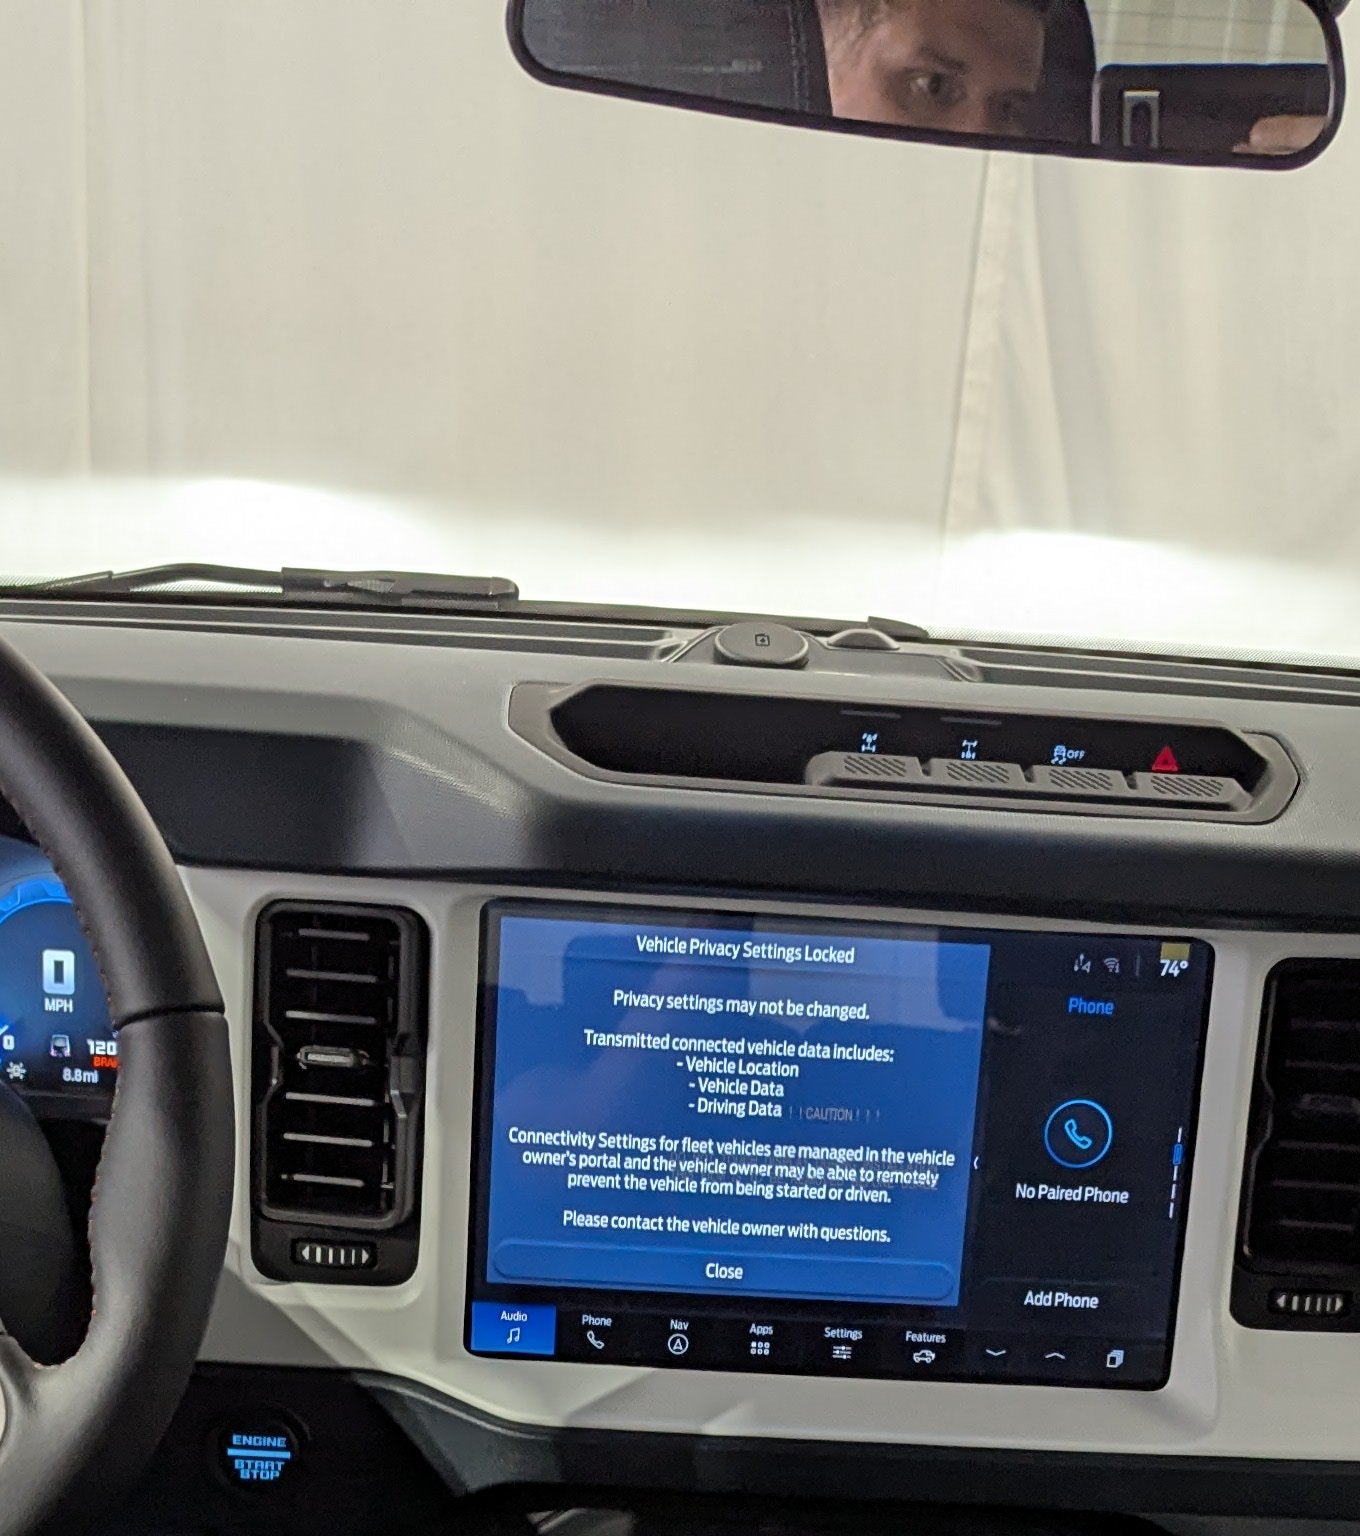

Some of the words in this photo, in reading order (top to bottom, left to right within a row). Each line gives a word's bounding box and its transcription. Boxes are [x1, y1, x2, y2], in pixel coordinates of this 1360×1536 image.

[1067, 750, 1085, 759] OFF
[636, 935, 687, 954] Vehicle
[689, 937, 740, 959] Privacy
[742, 941, 802, 963] Settings
[804, 945, 855, 964] Locked
[42, 949, 75, 995] 0
[44, 997, 74, 1013] MPH
[613, 989, 663, 1010] Privacy
[666, 993, 724, 1014] settings
[726, 998, 757, 1016] may
[759, 1000, 784, 1015] not
[786, 1000, 804, 1017] be
[806, 1003, 870, 1022] changed.
[1067, 996, 1114, 1016] Phone
[2, 1035, 15, 1050] 0
[584, 1029, 670, 1050] Transmitted
[671, 1034, 745, 1054] connected
[747, 1040, 796, 1058] vehicle
[797, 1041, 831, 1059] data
[832, 1044, 895, 1063] includes:
[686, 1056, 736, 1074] Vehicle
[738, 1059, 799, 1078] Location
[698, 1077, 748, 1096] Vehicle
[750, 1080, 784, 1098] Data
[697, 1097, 746, 1118] Driving
[748, 1100, 782, 1118] Data
[805, 1106, 853, 1122] CAUTION
[508, 1127, 596, 1149] Connectivity
[598, 1132, 656, 1152] Settings
[659, 1135, 680, 1151] for
[681, 1136, 713, 1154] fleet
[716, 1139, 771, 1157] vehicles
[774, 1145, 797, 1158] are
[798, 1146, 864, 1163] managed
[866, 1148, 880, 1162] in
[881, 1148, 905, 1164] the
[907, 1149, 955, 1167] vehicle
[522, 1151, 576, 1168] owner's
[579, 1153, 621, 1170] portal
[623, 1154, 650, 1171] and
[652, 1156, 676, 1172] the
[678, 1157, 727, 1176] vehicle
[729, 1162, 772, 1177] owner
[774, 1164, 805, 1181] may
[807, 1163, 824, 1179] be
[826, 1164, 856, 1182] able
[859, 1166, 874, 1182] to
[876, 1168, 939, 1188] remotely
[567, 1173, 621, 1190] prevent
[624, 1174, 648, 1191] the
[649, 1176, 698, 1193] vehicle
[700, 1178, 734, 1195] from
[735, 1181, 774, 1200] being
[776, 1182, 826, 1200] started
[828, 1187, 843, 1201] or
[845, 1186, 892, 1204] driven.
[1016, 1182, 1036, 1199] No
[1037, 1183, 1083, 1202] Paired
[1084, 1186, 1129, 1204] Phone
[563, 1210, 609, 1228] Please
[611, 1214, 664, 1231] contact
[666, 1216, 690, 1233] the
[691, 1217, 740, 1235] vehicle
[741, 1221, 786, 1238] owner
[787, 1222, 818, 1239] with
[820, 1225, 892, 1243] questions.
[705, 1262, 743, 1279] Close
[1024, 1291, 1053, 1308] Add
[1054, 1292, 1099, 1310] Phone
[500, 1310, 528, 1322] Audio
[581, 1314, 612, 1327] Phone
[670, 1319, 689, 1331] Nav
[749, 1323, 774, 1337] Apps
[824, 1327, 864, 1341] Settings
[905, 1331, 946, 1344] Features
[232, 1433, 287, 1448] ENGINE
[234, 1458, 285, 1471] START
[240, 1469, 280, 1480] STOP
